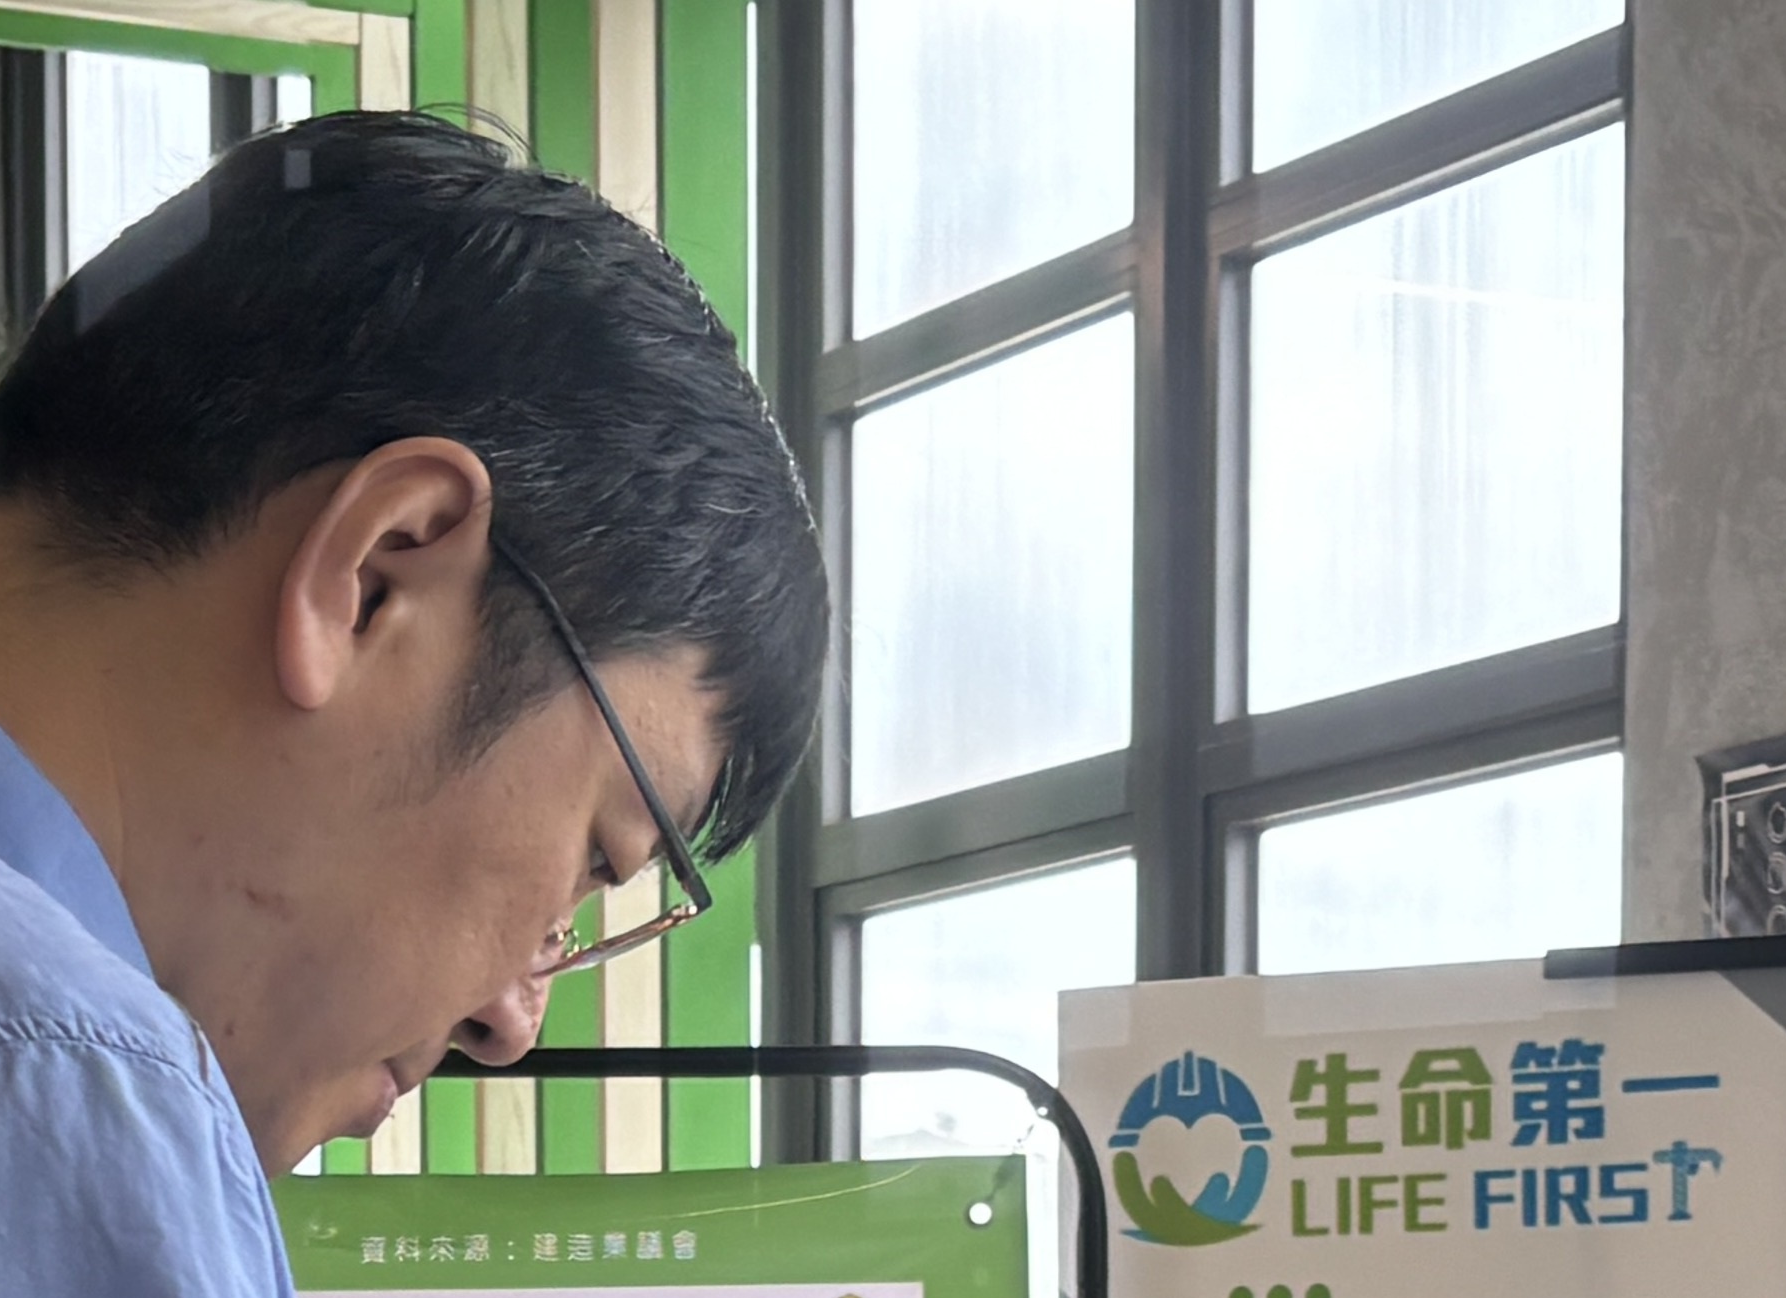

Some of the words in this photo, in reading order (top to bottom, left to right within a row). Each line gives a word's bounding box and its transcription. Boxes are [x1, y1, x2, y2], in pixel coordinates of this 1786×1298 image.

[1288, 1036, 1721, 1156] 生命第一
[1291, 1173, 1449, 1238] LIFE
[1472, 1139, 1724, 1231] FIRST
